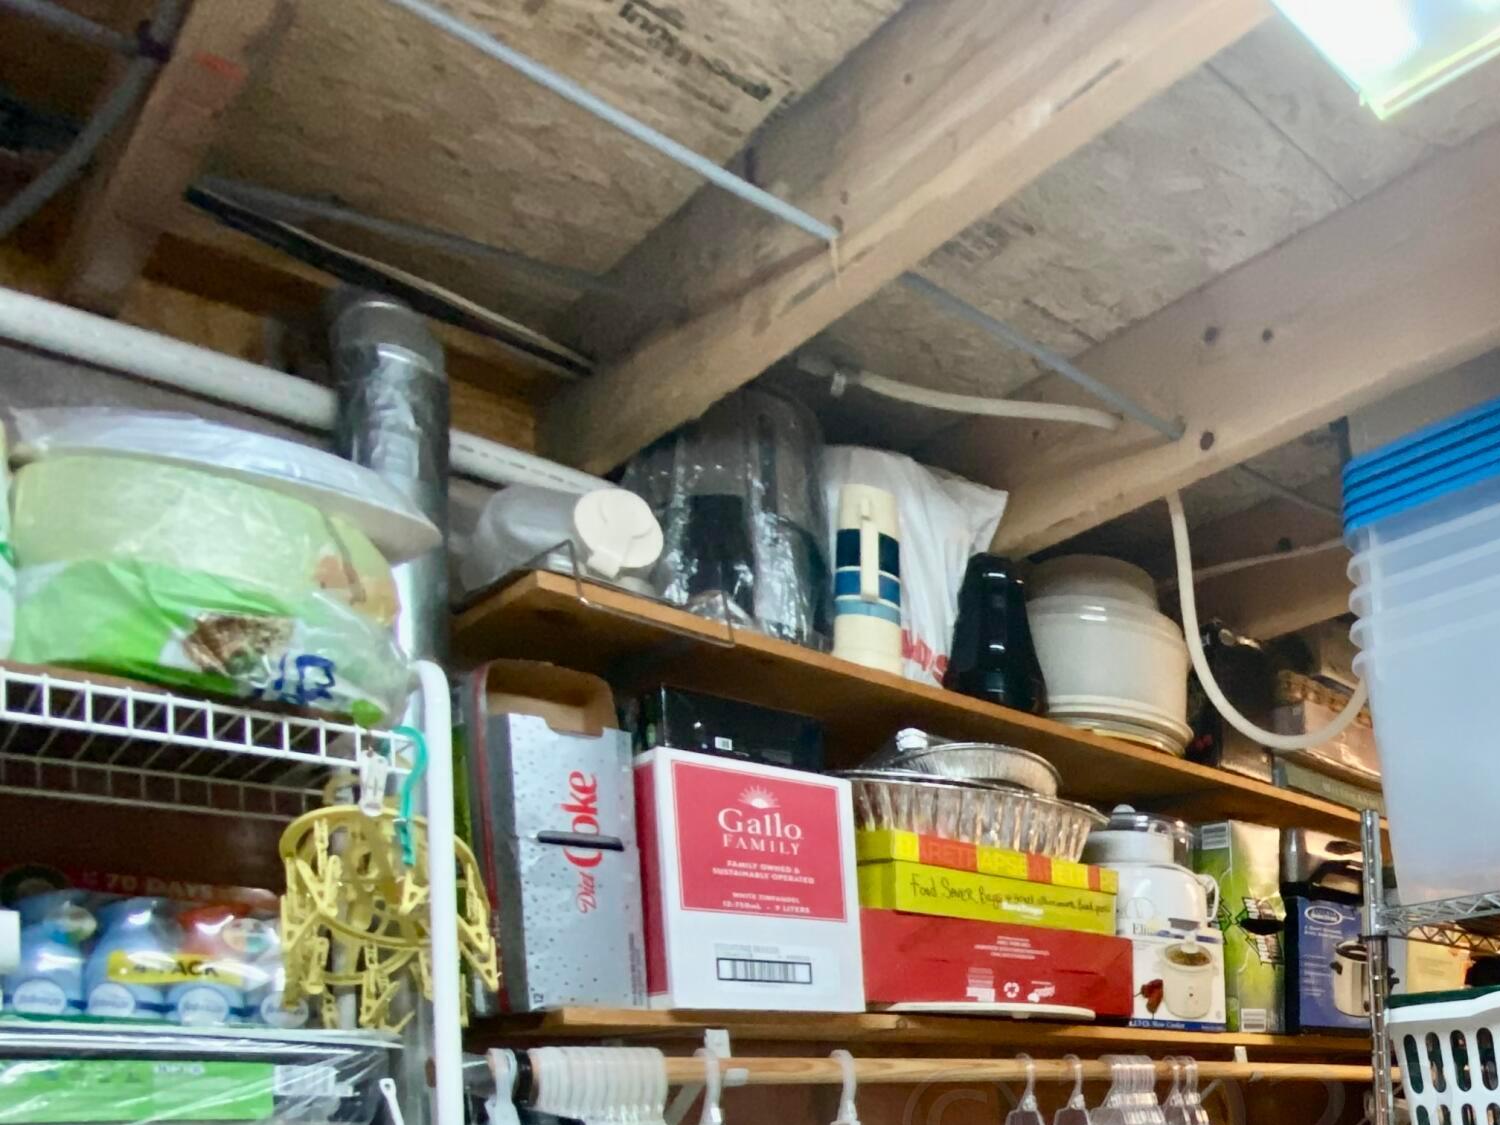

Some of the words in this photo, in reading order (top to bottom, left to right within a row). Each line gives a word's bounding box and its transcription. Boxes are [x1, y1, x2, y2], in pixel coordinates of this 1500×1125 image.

[717, 807, 802, 840] Gallo
[722, 833, 801, 856] FAMILY
[771, 872, 815, 885] OPERATED
